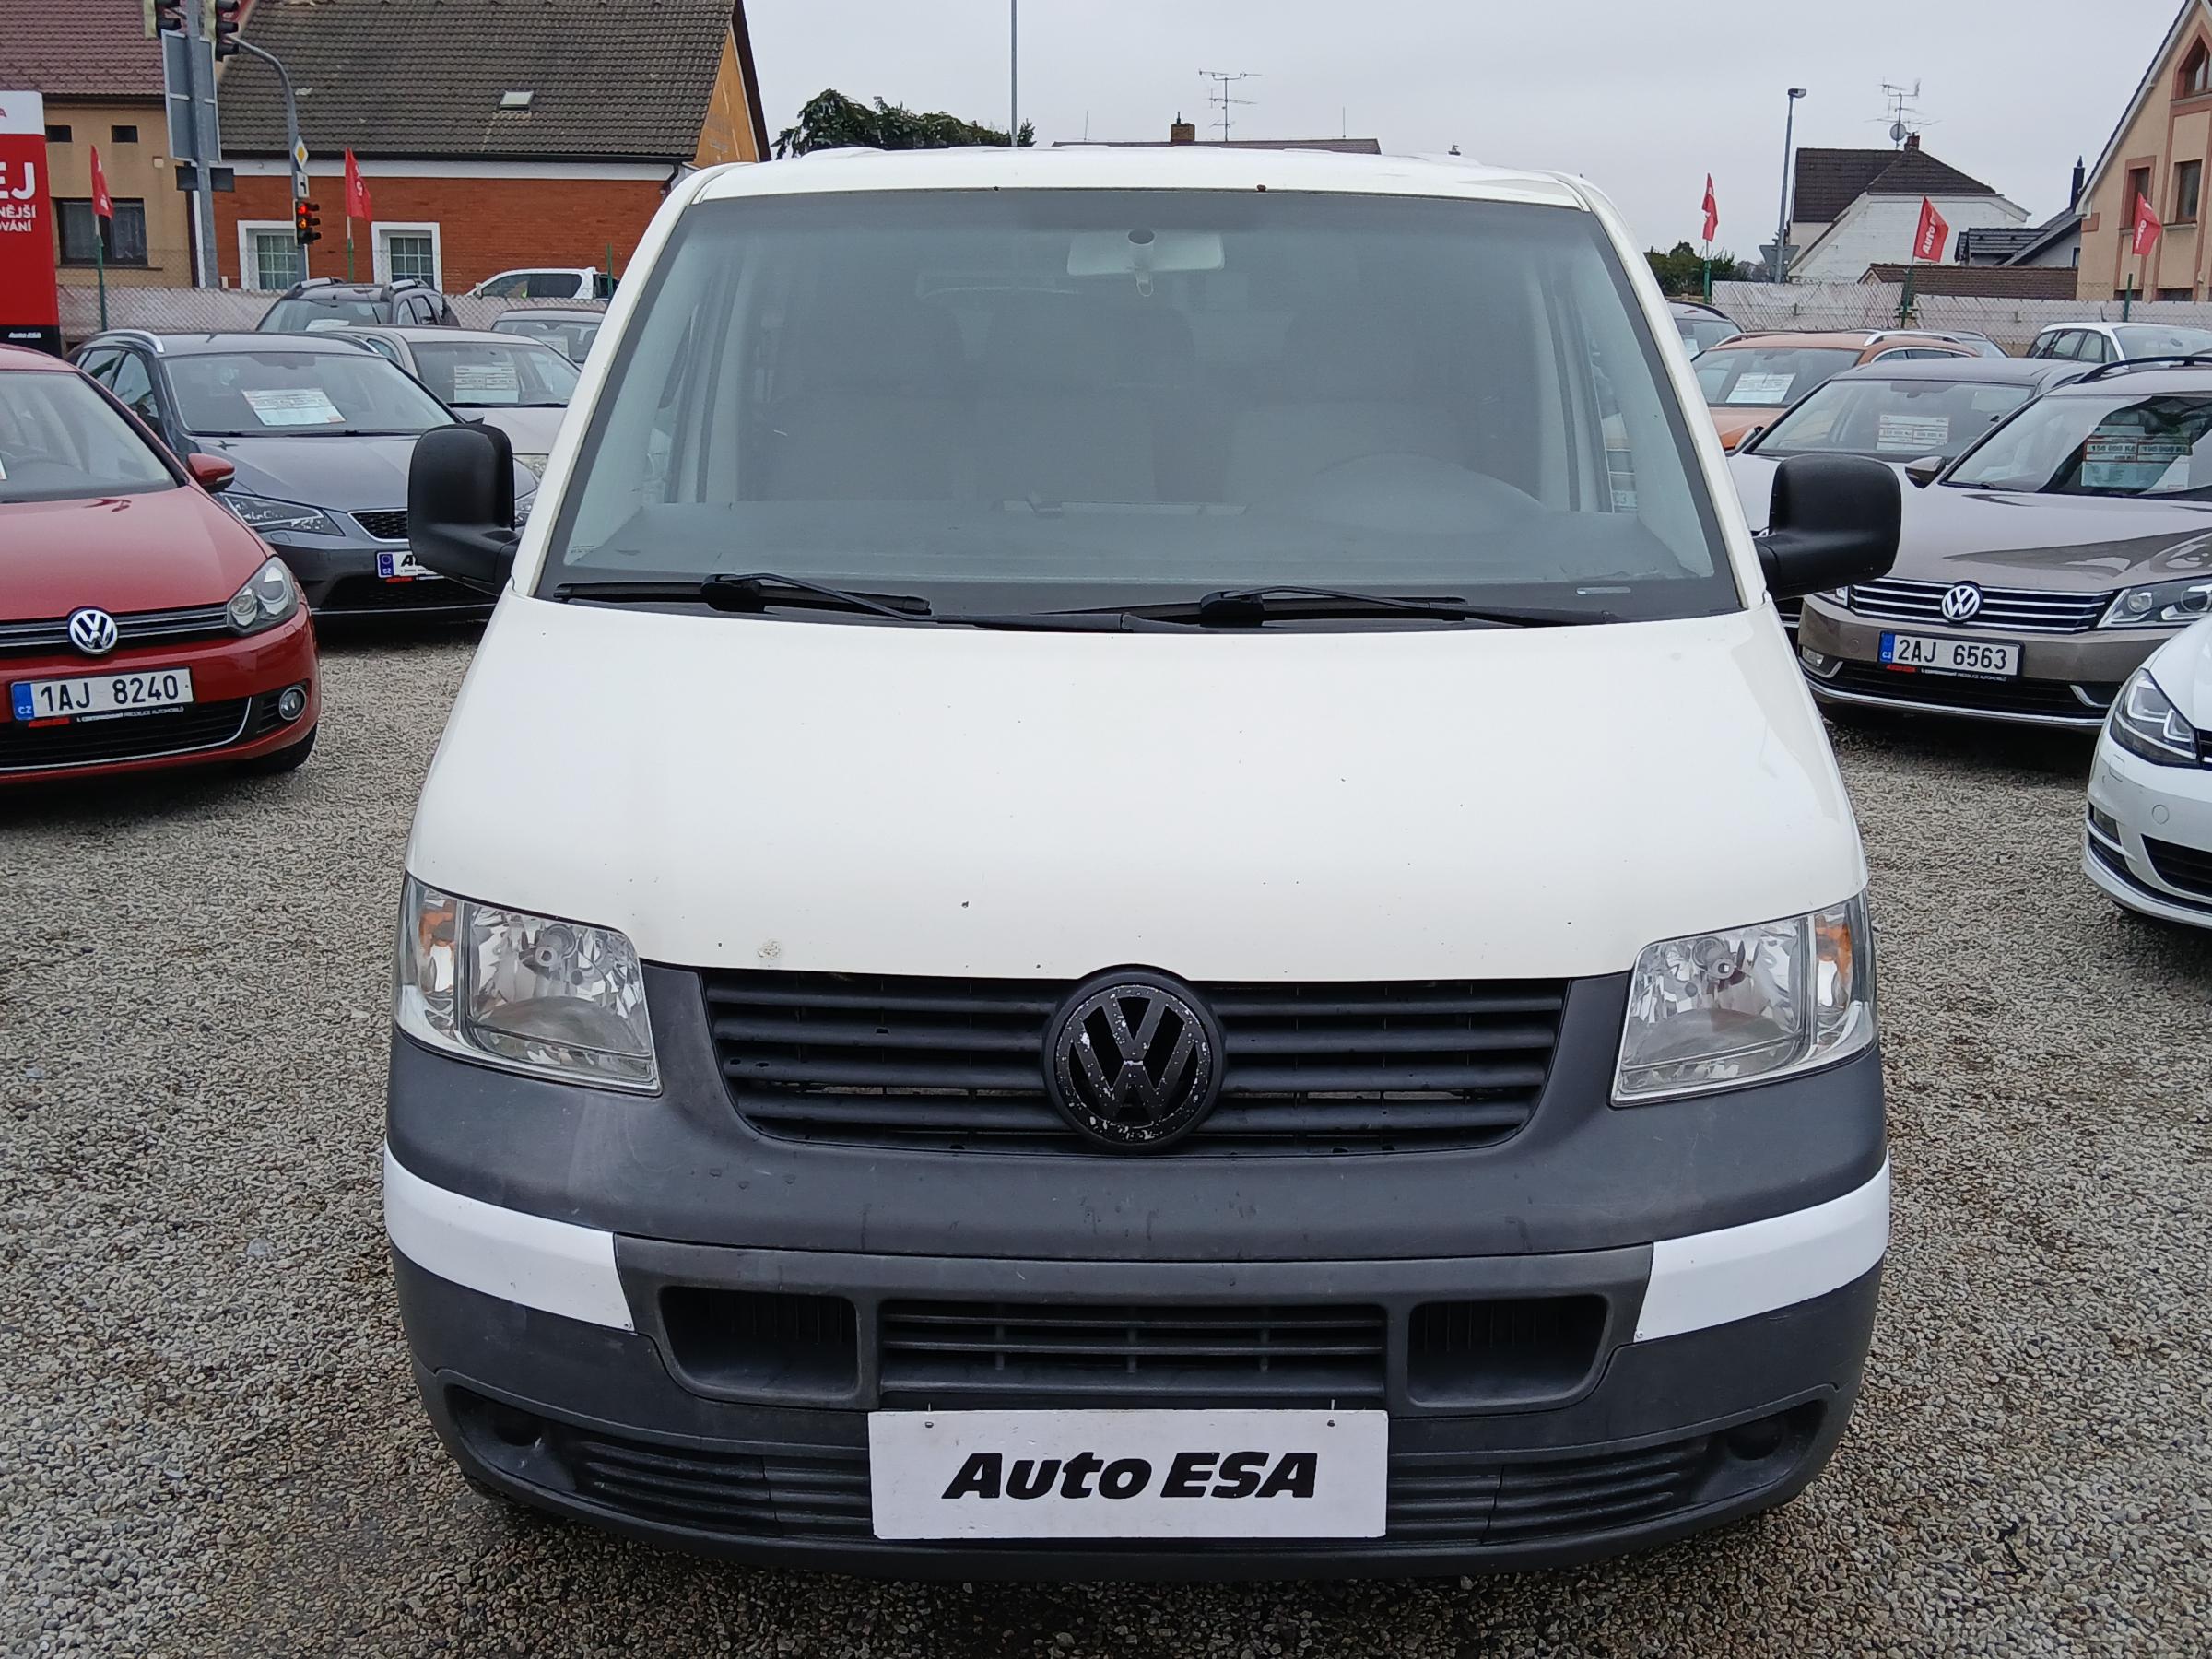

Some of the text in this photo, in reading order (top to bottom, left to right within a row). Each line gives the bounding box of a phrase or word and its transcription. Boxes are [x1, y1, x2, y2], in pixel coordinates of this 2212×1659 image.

[0, 219, 32, 231] VÁNÍ
[1898, 639, 2007, 670] 2AJ 6563
[41, 675, 179, 712] 1AJ 8240
[18, 706, 32, 714] CZ
[941, 1452, 1318, 1500] Auto ESA
